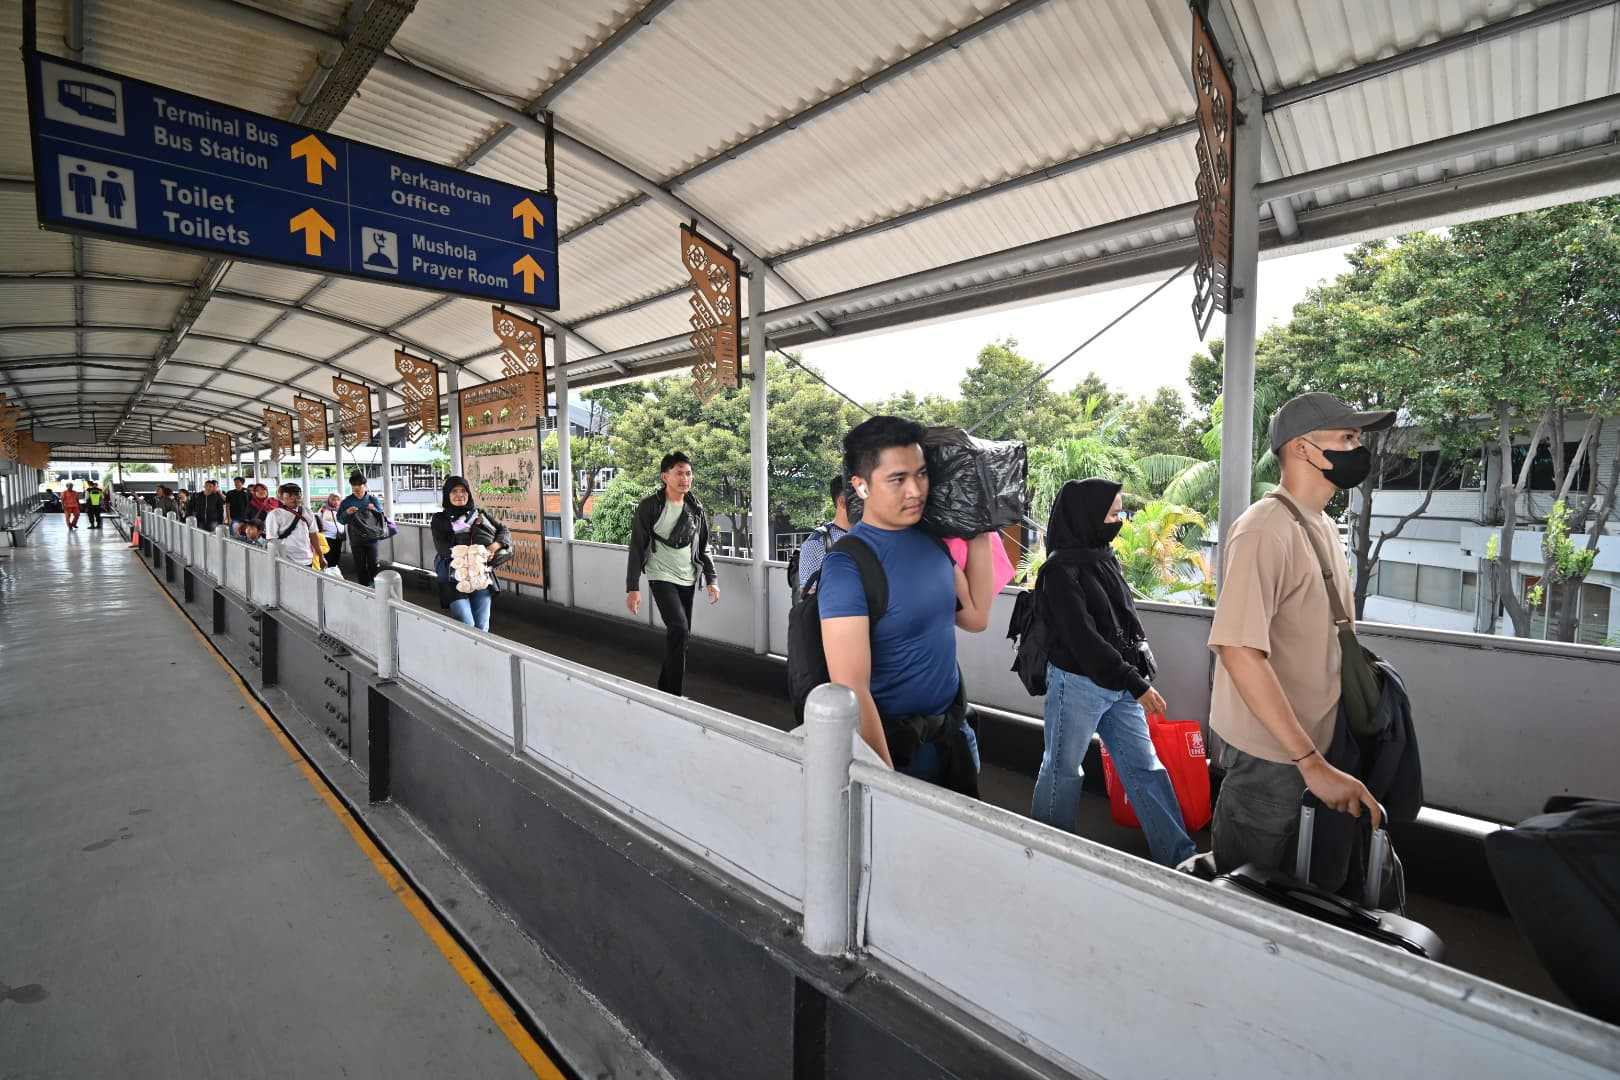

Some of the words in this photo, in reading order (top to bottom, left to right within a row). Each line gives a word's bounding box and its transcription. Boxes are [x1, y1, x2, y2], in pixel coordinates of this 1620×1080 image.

[153, 98, 239, 136] Terminal
[245, 122, 279, 147] Bus
[154, 126, 193, 152] Bus
[199, 138, 268, 170] Station
[160, 179, 235, 214] Toilet
[390, 165, 491, 206] Perkantoran
[391, 189, 451, 216] Office
[163, 211, 250, 246] Toilets
[412, 233, 477, 262] Mushola
[412, 255, 463, 281] Prayer
[468, 266, 509, 289] Room
